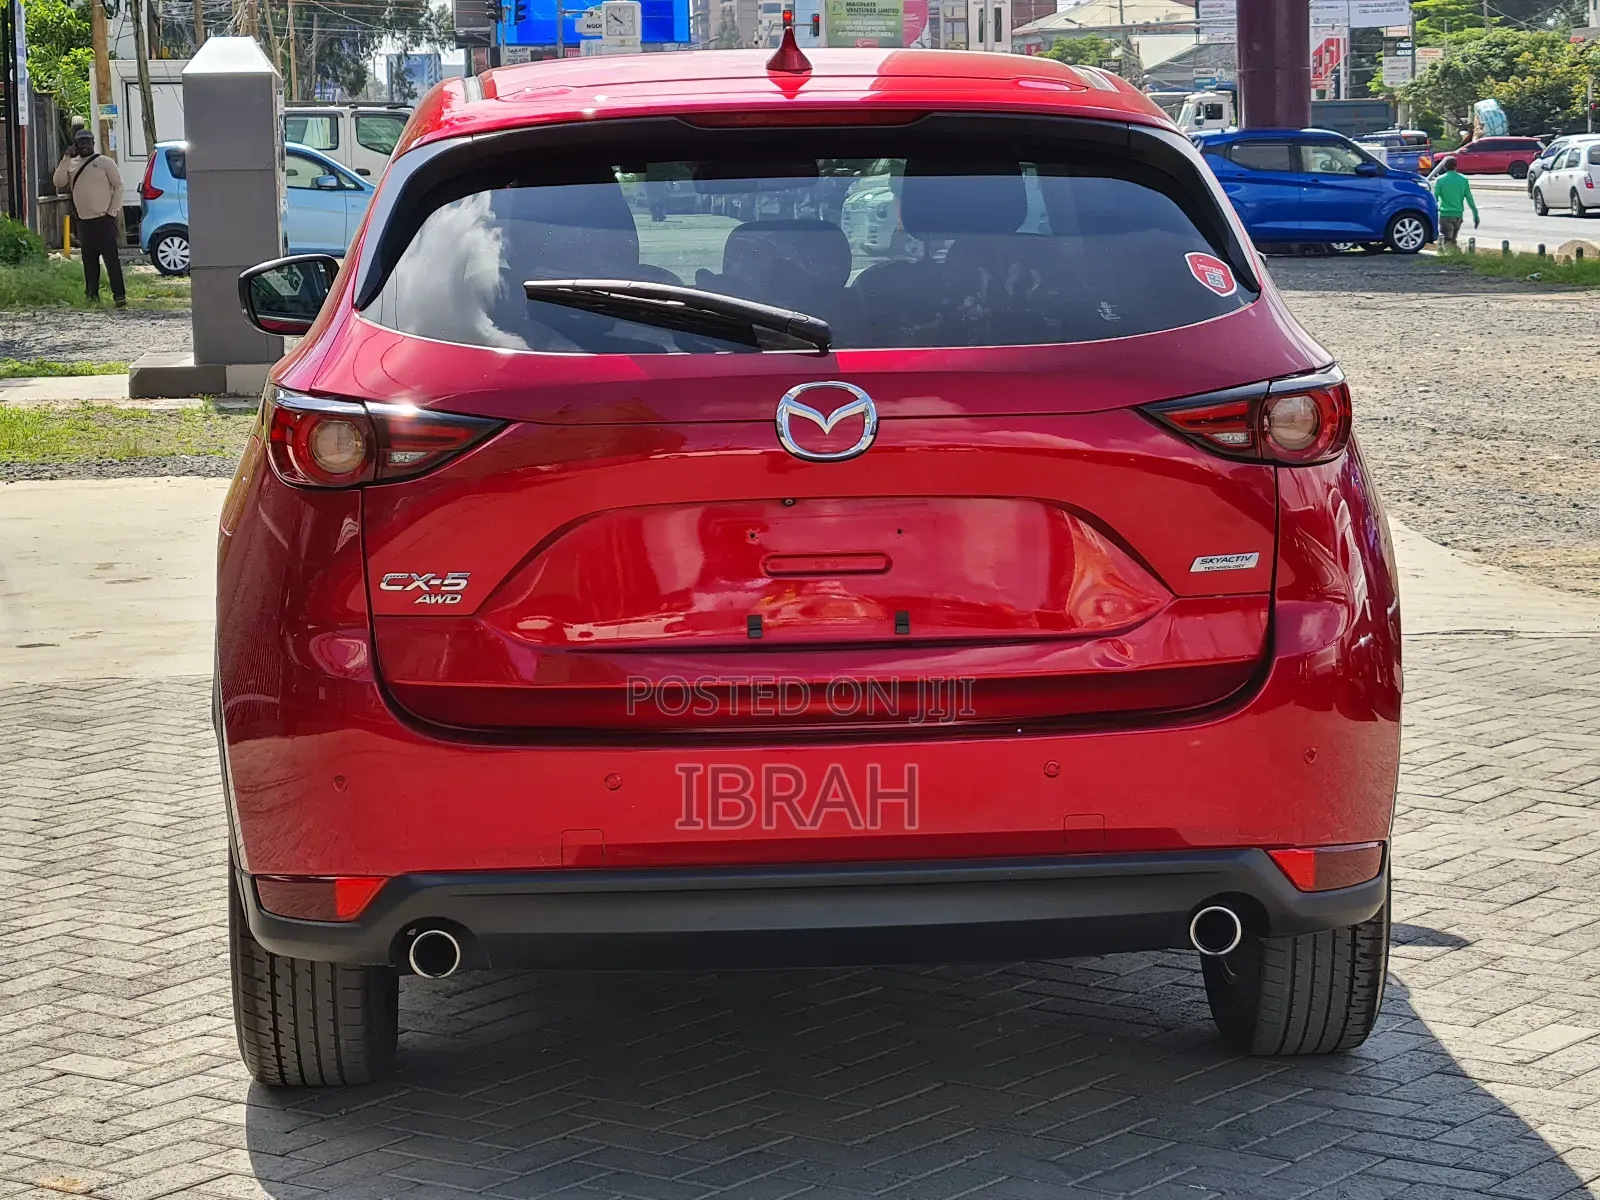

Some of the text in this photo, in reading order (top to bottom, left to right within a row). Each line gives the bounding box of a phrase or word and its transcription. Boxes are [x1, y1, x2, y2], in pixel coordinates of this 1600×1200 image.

[1199, 555, 1253, 564] SKYACTIV
[380, 572, 472, 591] CX-5
[413, 593, 463, 604] AWD
